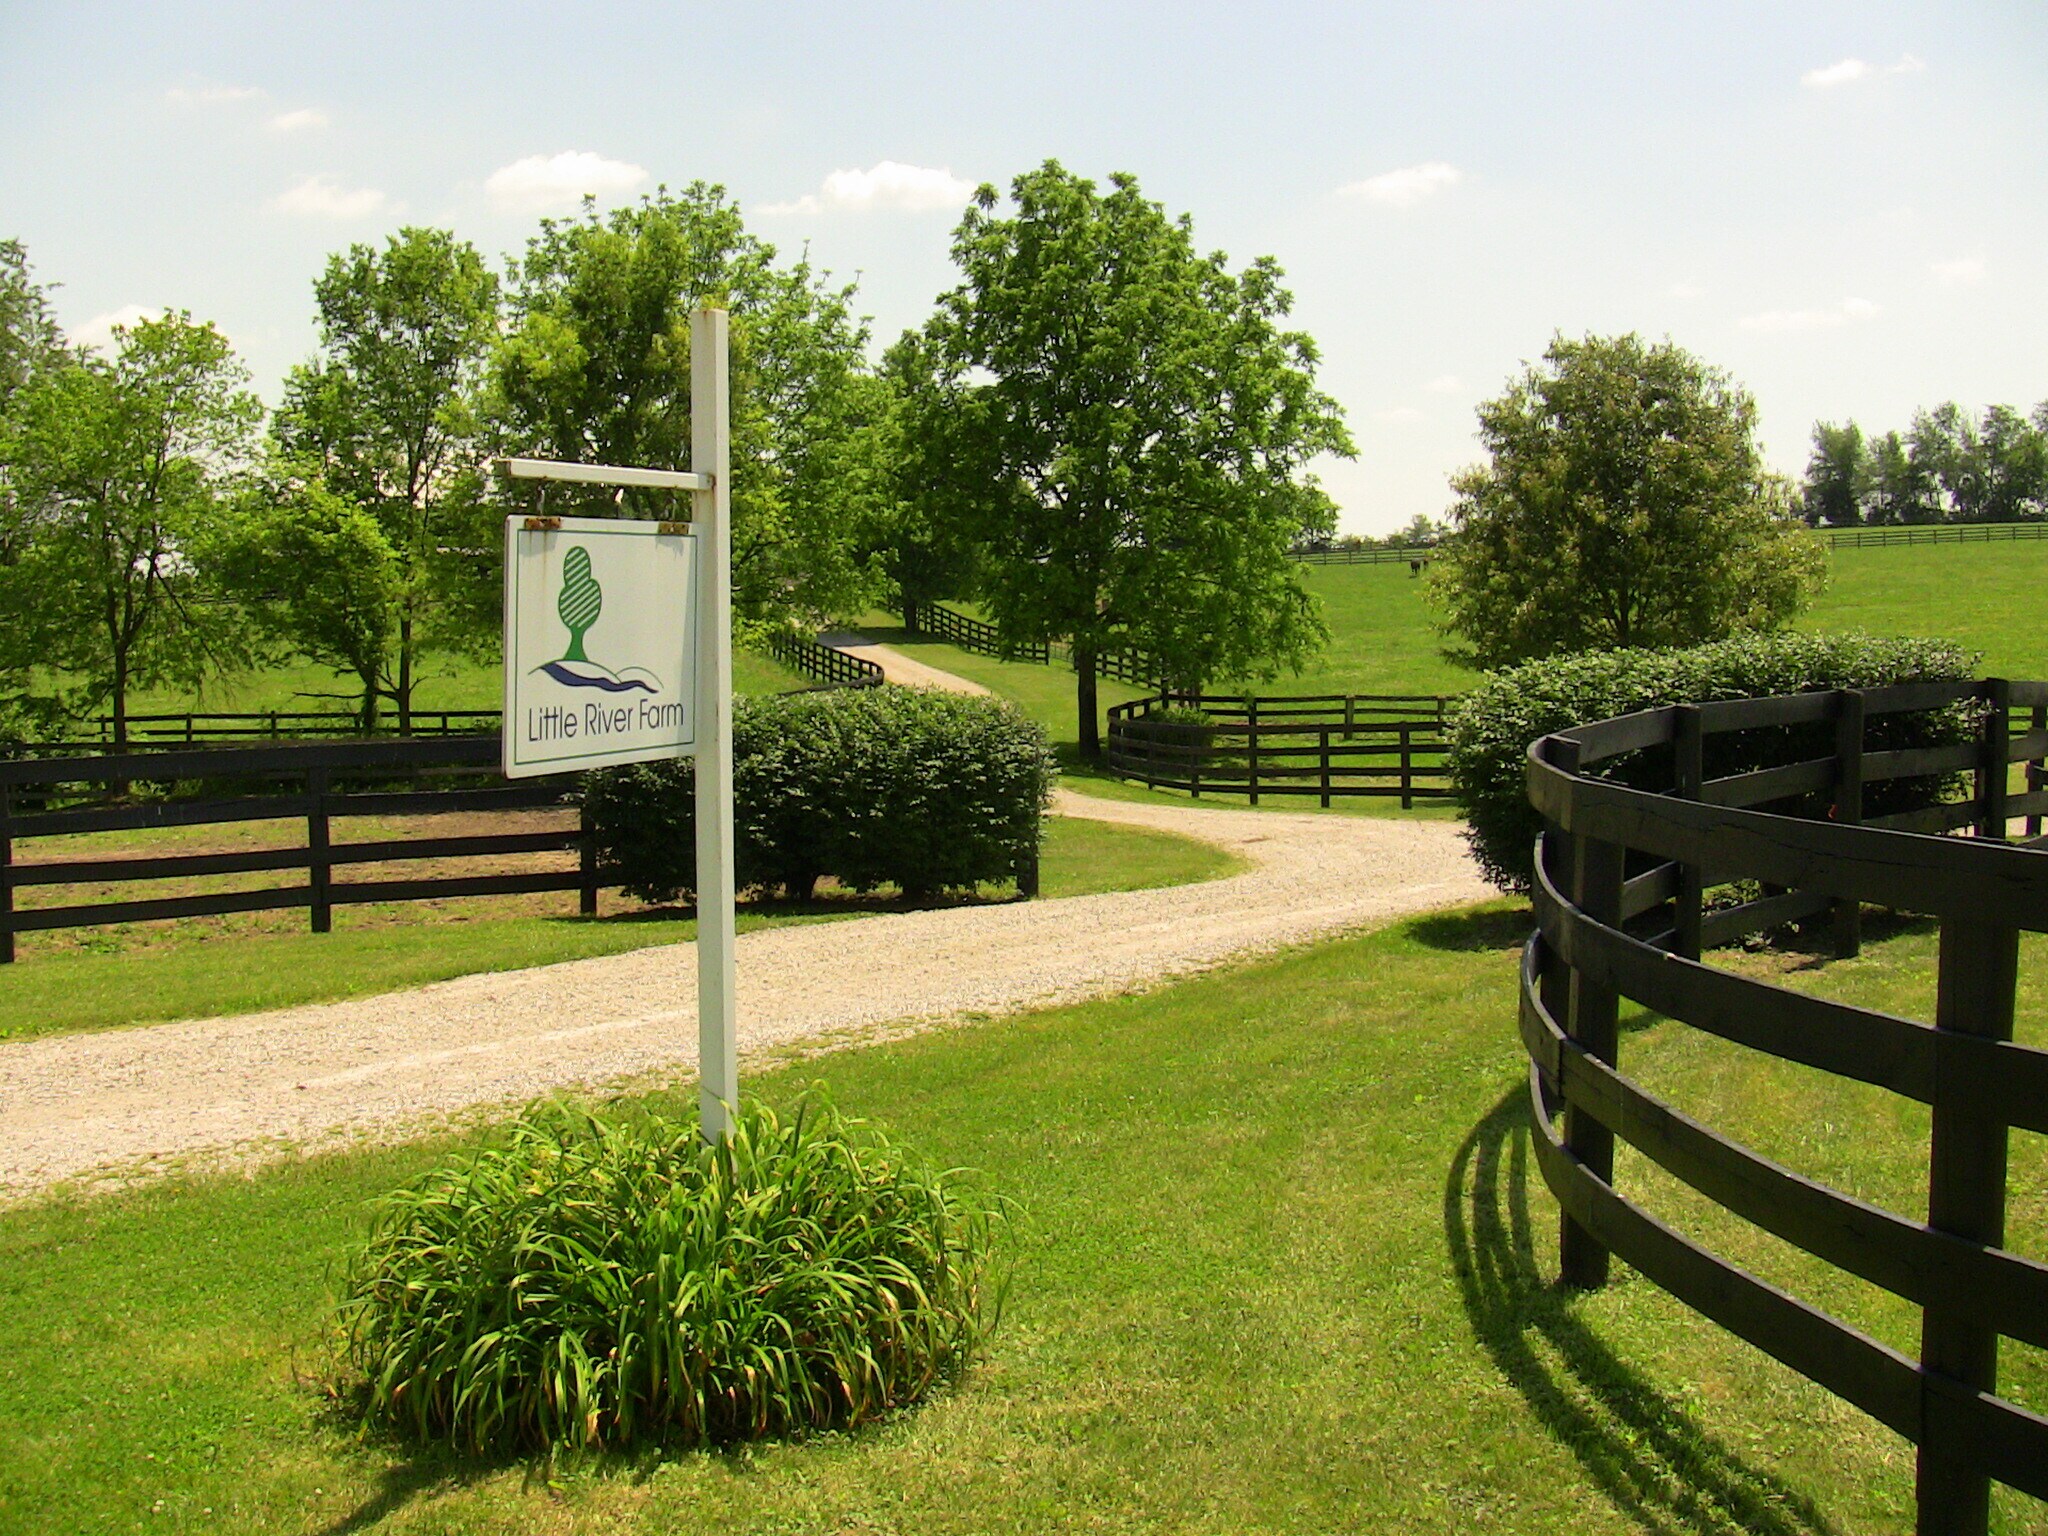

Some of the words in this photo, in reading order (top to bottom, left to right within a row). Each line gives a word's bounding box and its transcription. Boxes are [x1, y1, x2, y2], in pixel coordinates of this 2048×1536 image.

[529, 706, 578, 742] Little
[585, 702, 633, 736] River
[639, 698, 684, 730] Farm
